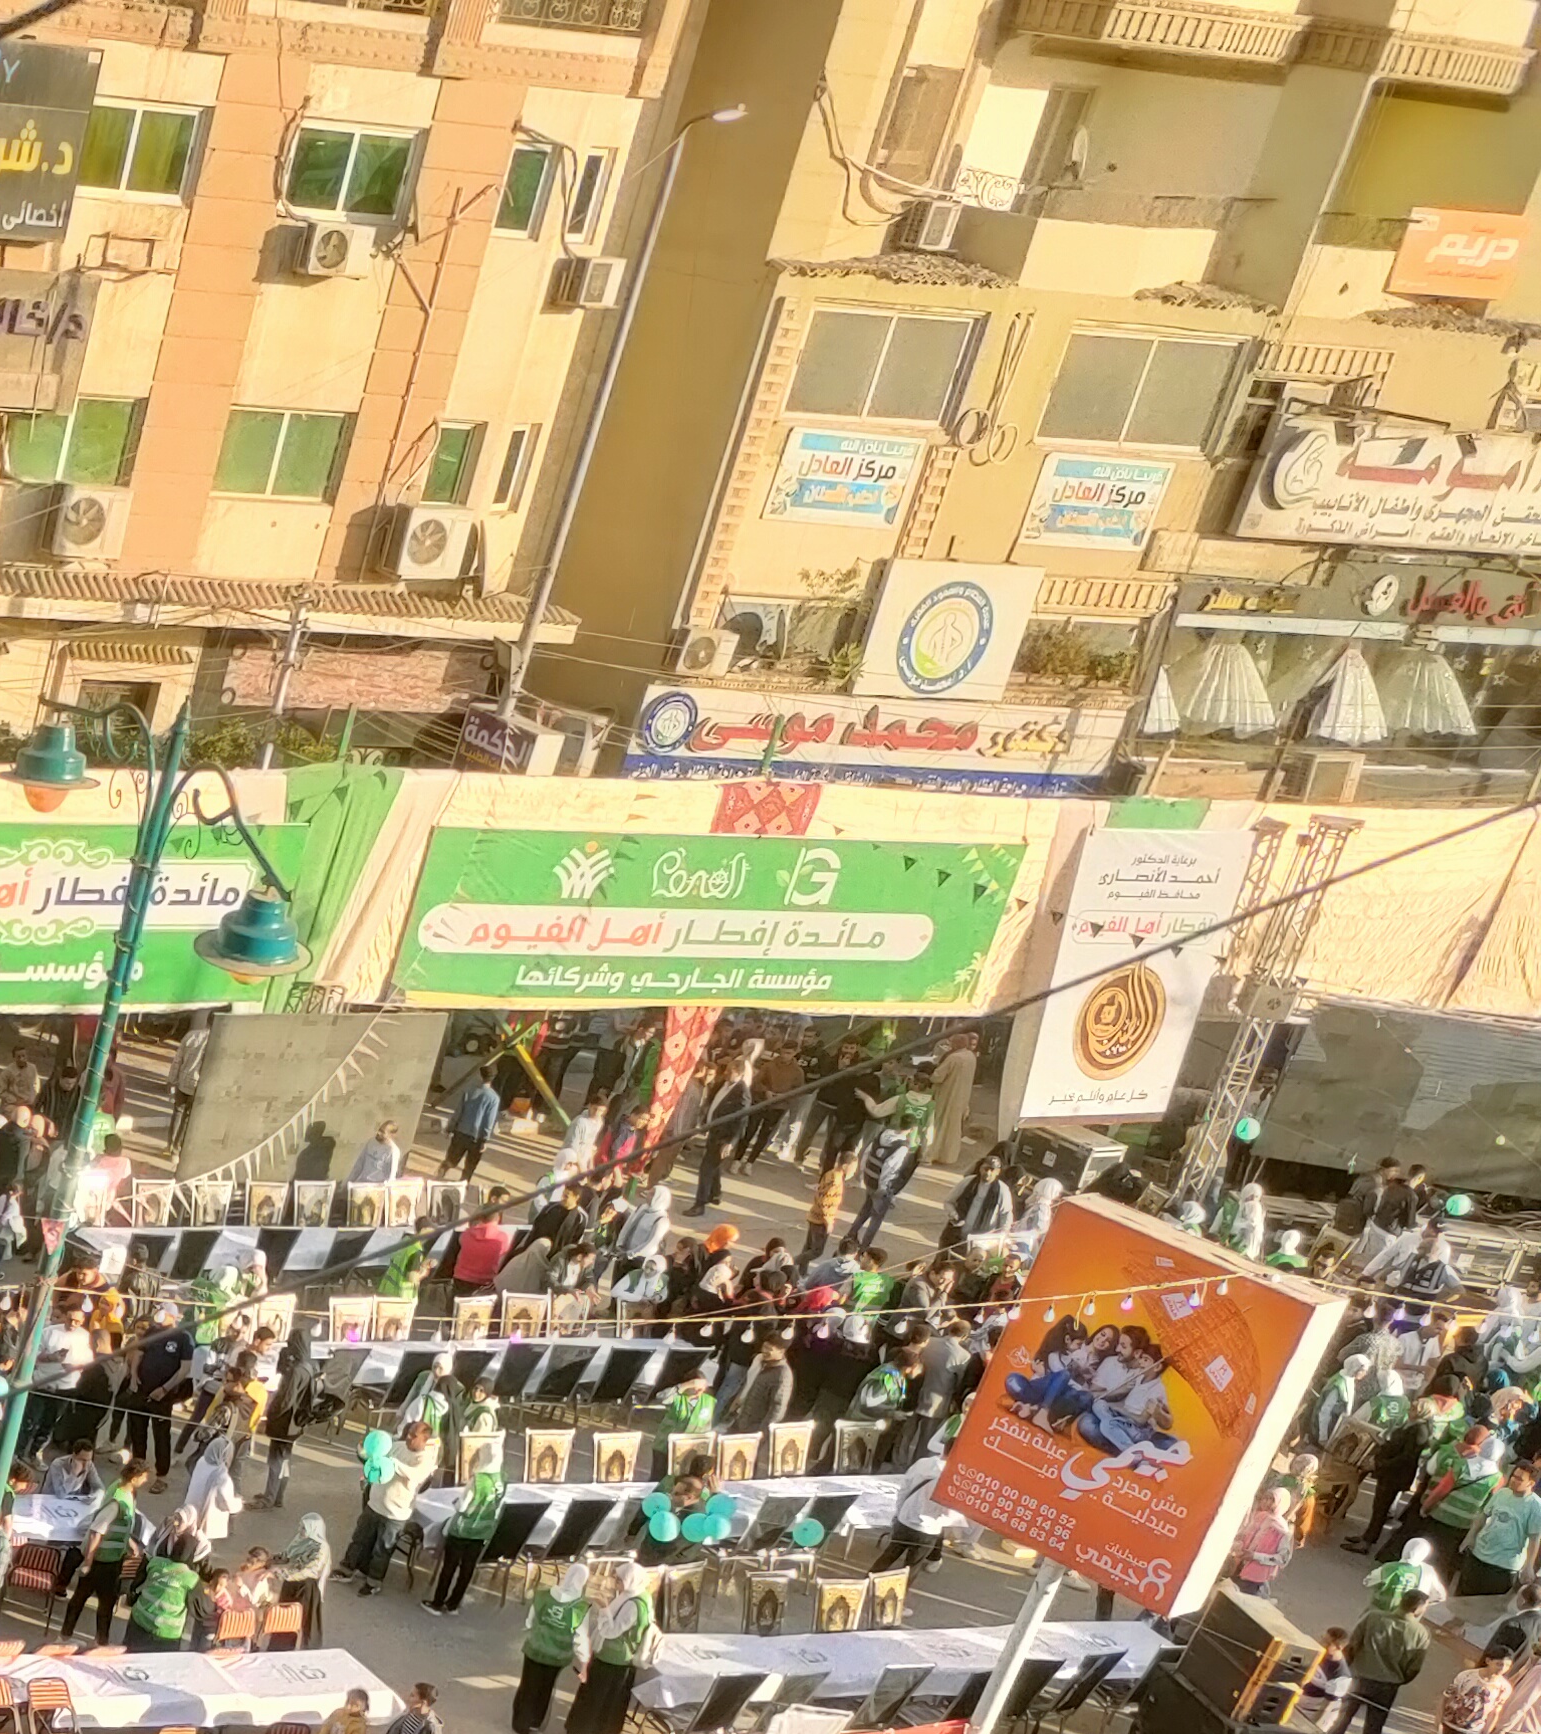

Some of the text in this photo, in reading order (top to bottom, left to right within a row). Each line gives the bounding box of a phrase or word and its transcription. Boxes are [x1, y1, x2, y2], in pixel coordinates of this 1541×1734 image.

[1424, 233, 1519, 267] دريم
[798, 456, 897, 482] مركز العادل
[1052, 483, 1146, 506] مركز العادل
[685, 711, 834, 754] موسى
[843, 706, 979, 750] محمد
[1131, 854, 1196, 867] برعاية الدكتور
[1171, 869, 1219, 885] أحمد
[150, 873, 241, 908] مائدة
[1107, 889, 1201, 900] محافظ الفيوم
[465, 913, 886, 954] مائدة إفطار أهل الفيوم
[517, 964, 832, 992] مؤسسة الجارحي وشركائها
[983, 1436, 1058, 1479] فيك
[988, 1416, 1067, 1460] عيلة بتفكر
[971, 1483, 1070, 1540] 010 90 95 14 96
[975, 1473, 1076, 1529] 010 00 08 60 52
[1102, 1492, 1178, 1538] صيدلية
[1113, 1475, 1188, 1518] مش مجرد
[965, 1495, 1066, 1552] 010 64 68 83 64
[1076, 1543, 1139, 1586] جيمي
[1105, 1542, 1147, 1568] صيدليات
